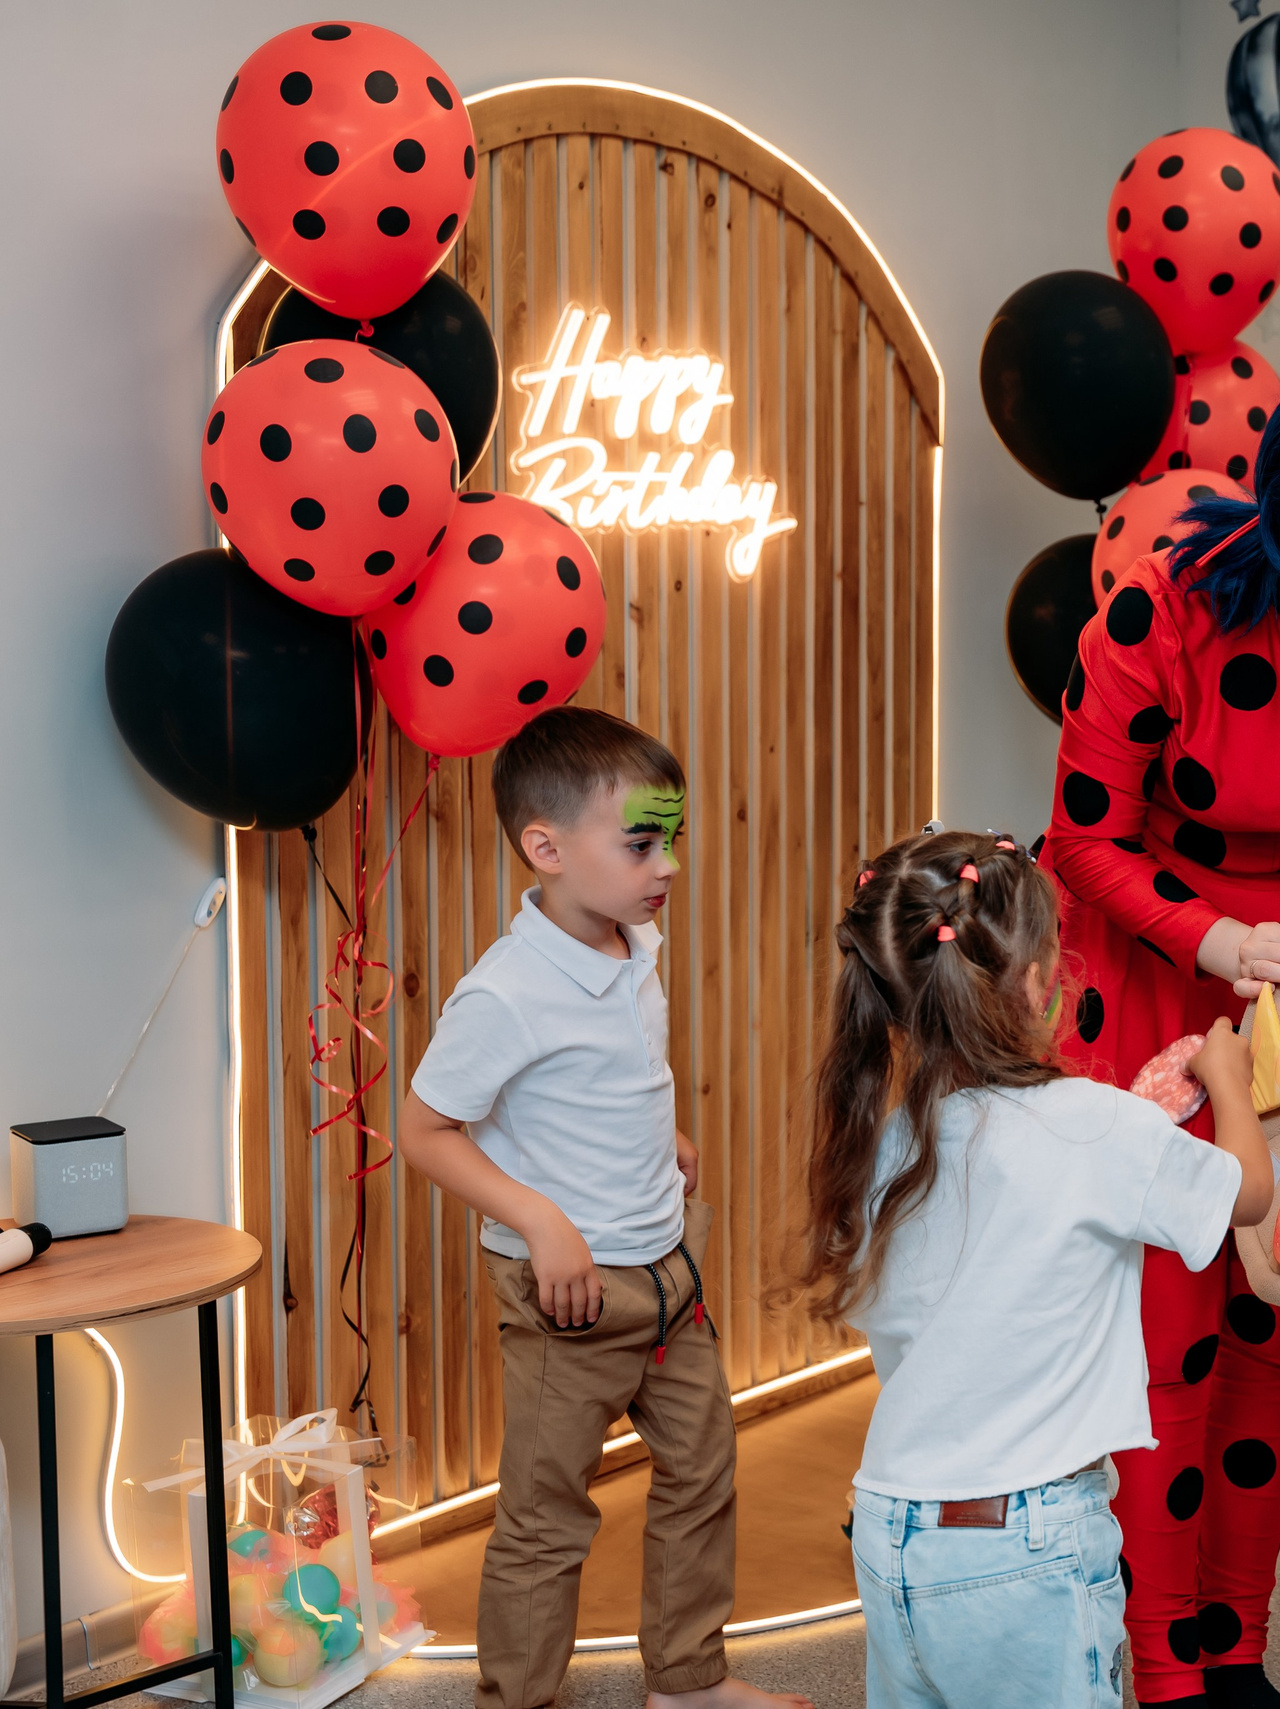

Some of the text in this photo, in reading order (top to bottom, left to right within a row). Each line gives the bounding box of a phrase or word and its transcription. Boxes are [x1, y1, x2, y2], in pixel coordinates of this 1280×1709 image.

[519, 307, 734, 445] Happy
[517, 436, 798, 576] Birthday
[62, 1161, 114, 1184] 15:04
